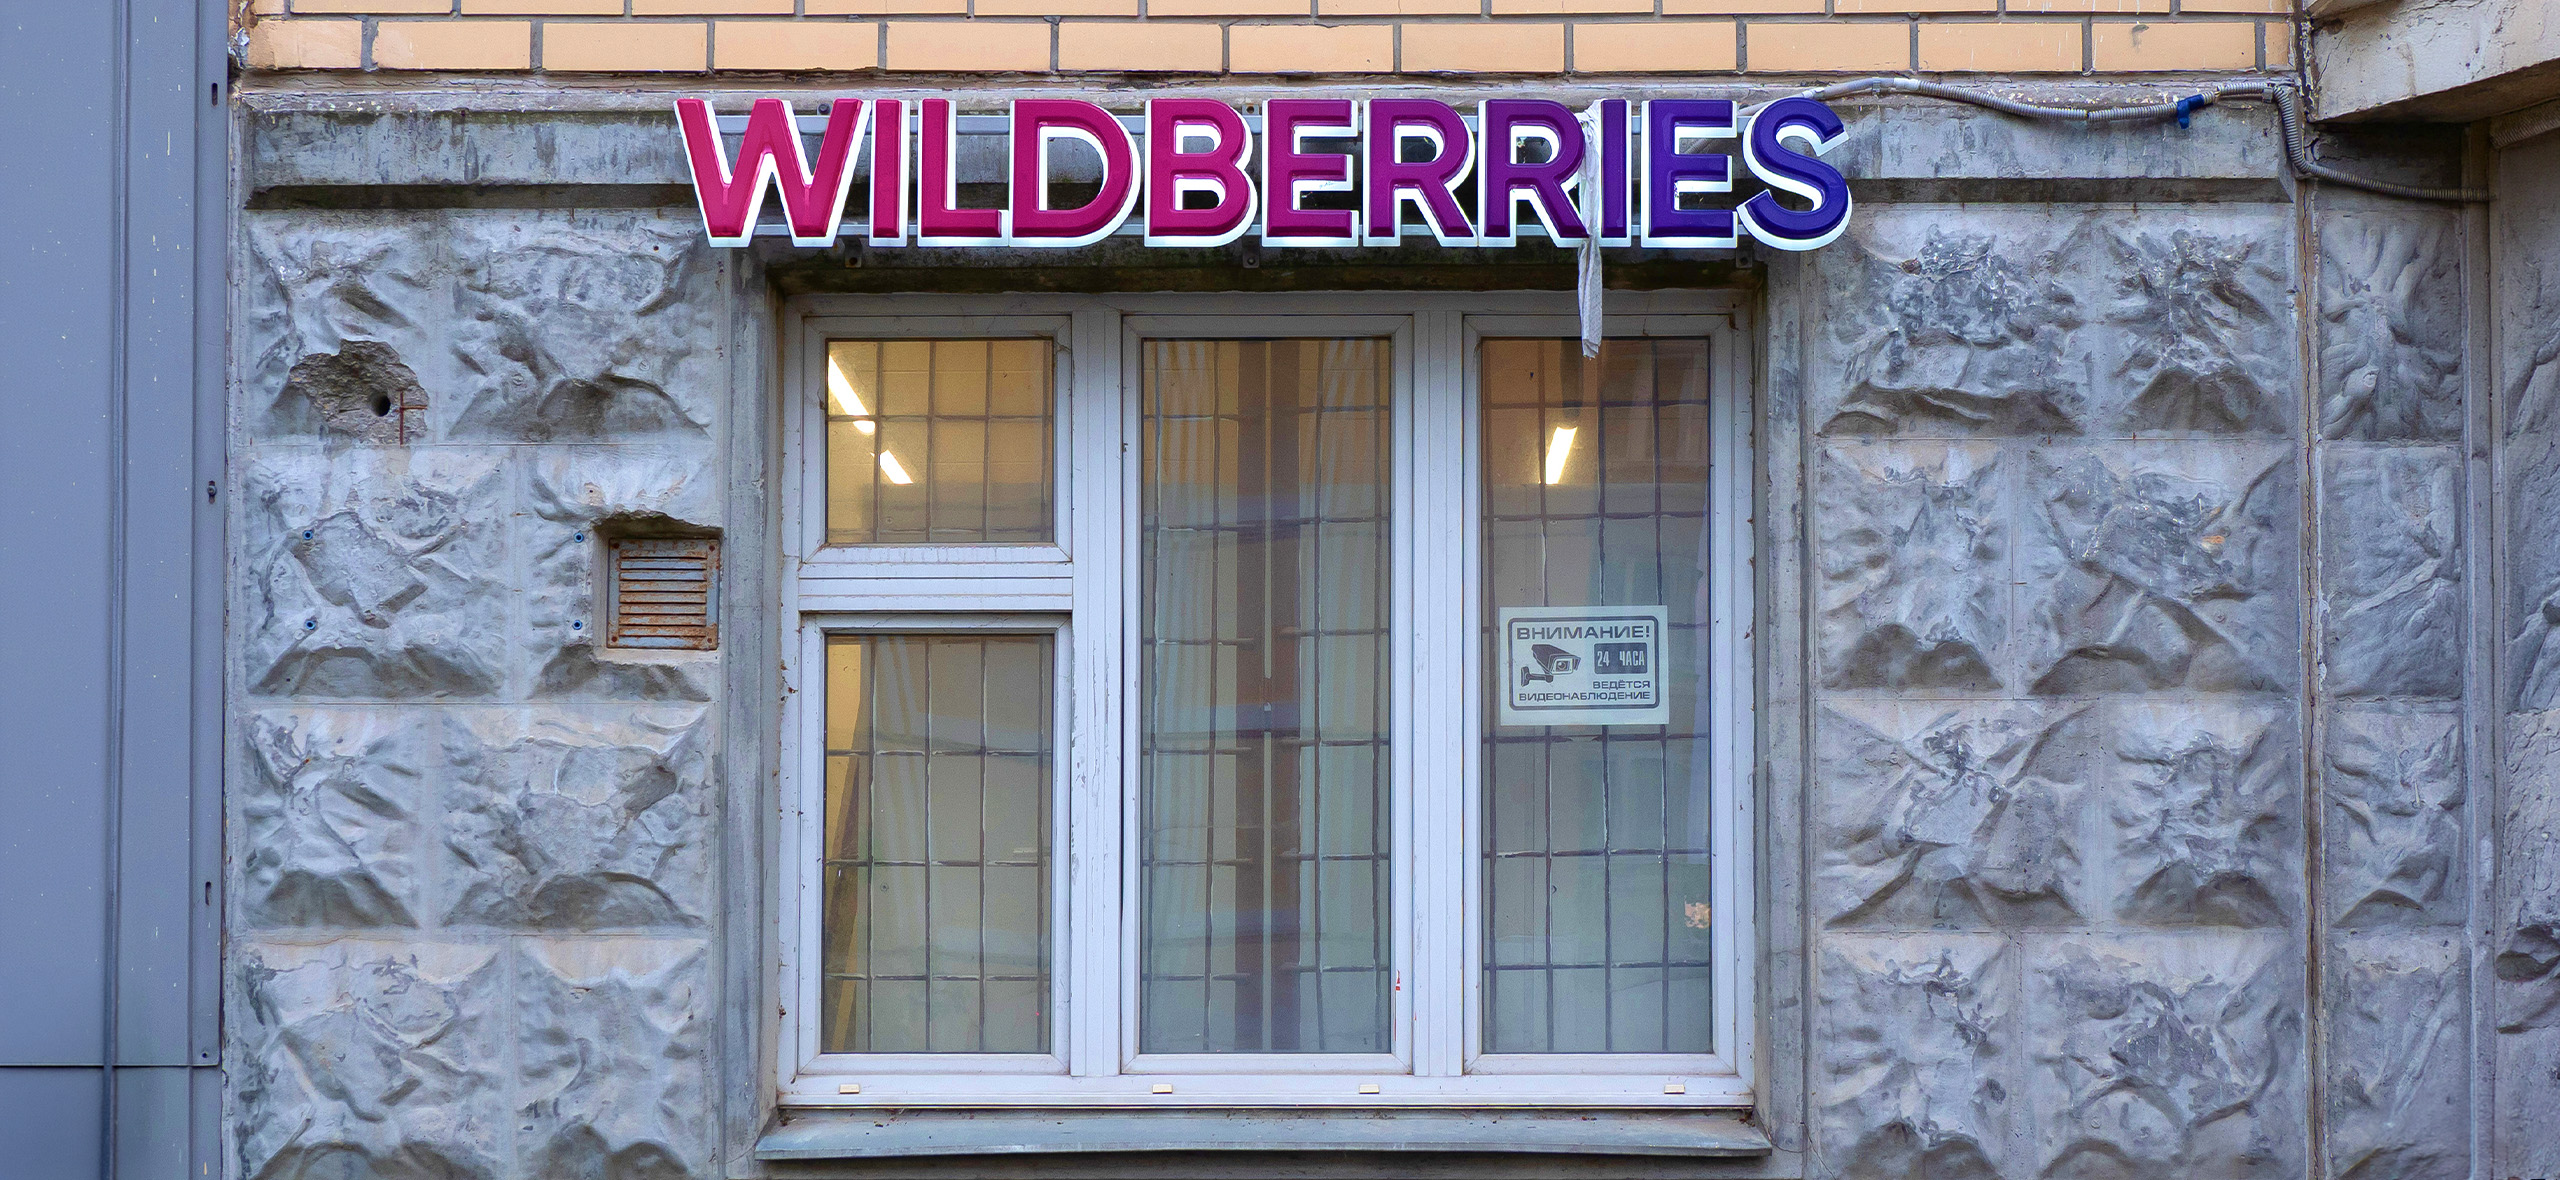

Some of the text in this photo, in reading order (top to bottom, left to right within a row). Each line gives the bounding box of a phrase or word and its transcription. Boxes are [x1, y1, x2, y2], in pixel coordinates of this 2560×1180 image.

[674, 98, 1852, 251] WILDBERRIES
[1516, 626, 1650, 640] ВНИМАНИЕ!
[1597, 650, 1645, 667] 24 ЧАСА
[1592, 680, 1650, 690] ВЕДЁТСЯ
[1519, 691, 1650, 702] ВИДЕОНАБЛЮДЕНИЕ
